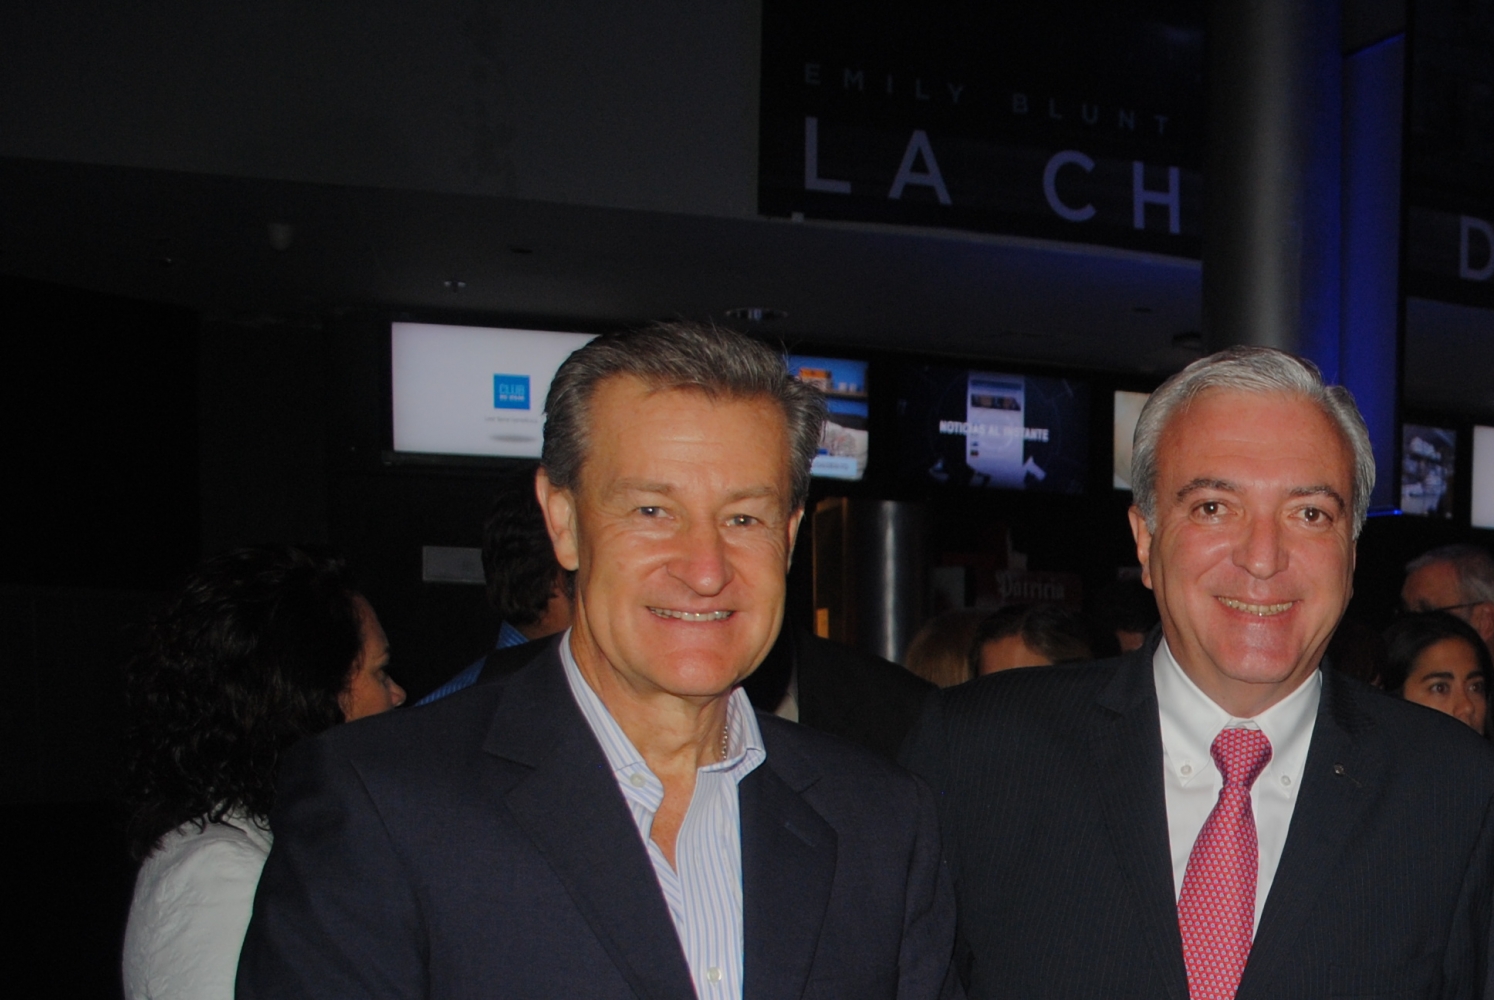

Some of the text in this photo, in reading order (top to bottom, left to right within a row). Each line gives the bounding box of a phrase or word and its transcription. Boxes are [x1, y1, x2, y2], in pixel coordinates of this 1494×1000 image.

[804, 63, 1169, 135] EMILY BLUNT
[803, 115, 953, 206] LA
[499, 383, 525, 396] CLUB
[938, 419, 1050, 444] NOTICIAS AL INSTANTE
[995, 570, 1066, 604] Patricia
